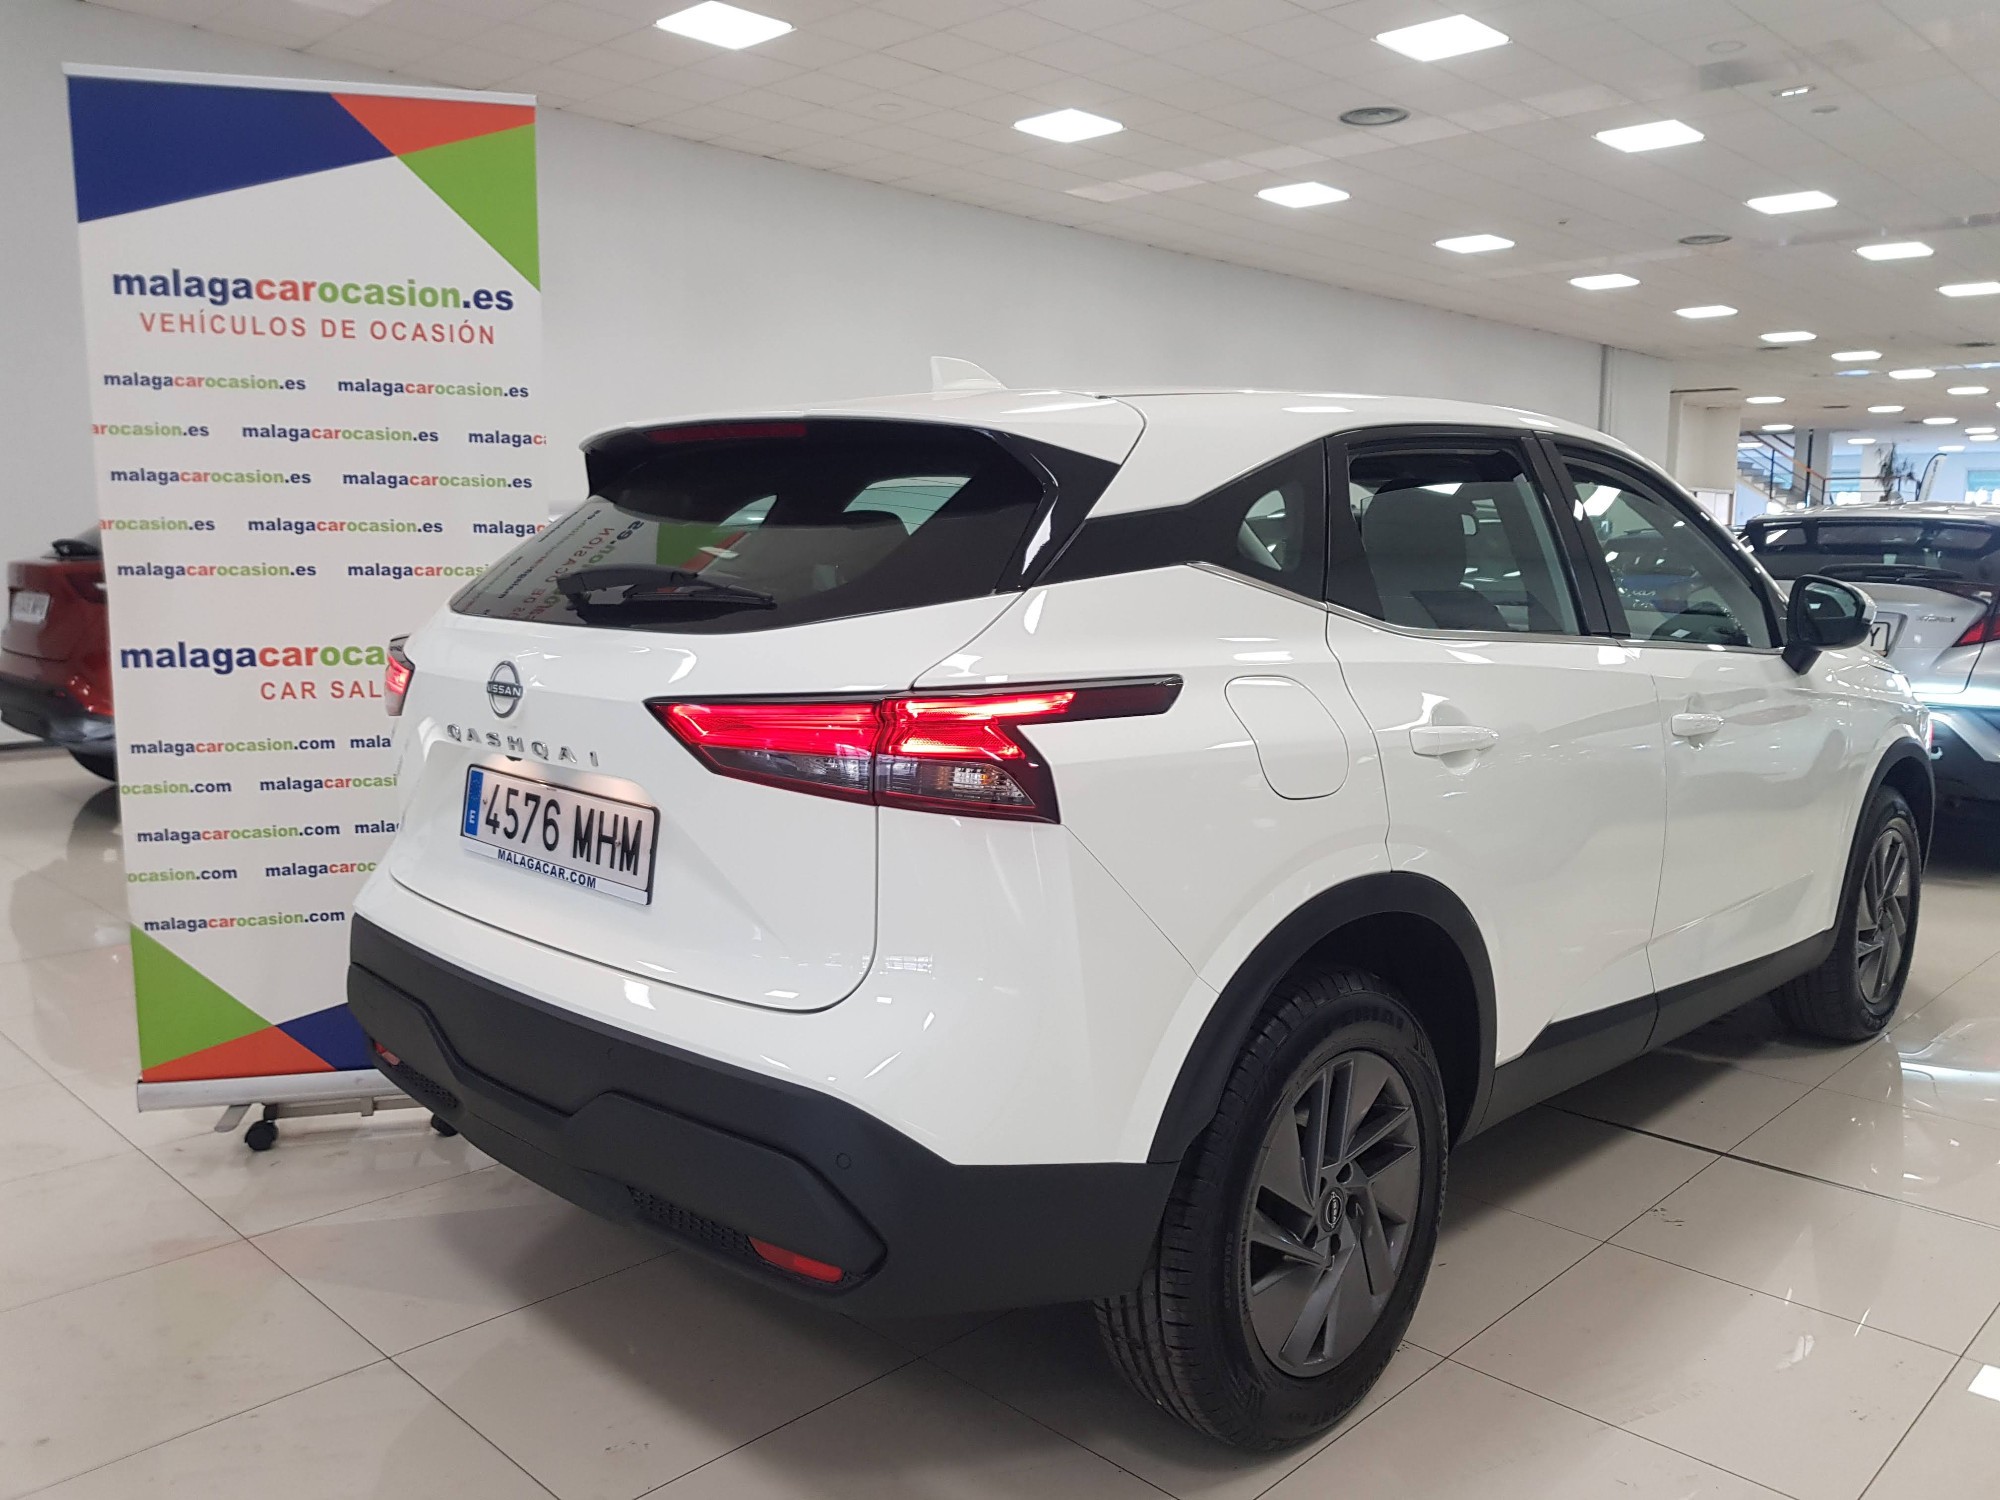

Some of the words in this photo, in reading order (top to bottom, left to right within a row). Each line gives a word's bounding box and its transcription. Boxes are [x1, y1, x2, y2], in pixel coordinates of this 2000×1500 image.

[113, 269, 515, 310] malagacarocasion.es
[140, 309, 305, 337] VEHÍCULOS
[321, 319, 356, 339] DE
[370, 319, 494, 345] OCASIÓN
[104, 371, 307, 391] malagacarocasion.es
[337, 377, 530, 398] malagacarocasion.es
[242, 423, 439, 443] malagacarocasion.es
[110, 467, 311, 486] malagacarocasion.es
[342, 470, 533, 490] malagacarocasion.es
[247, 516, 443, 536] malagacarocasion.es
[473, 520, 546, 538] malagac
[116, 561, 317, 580] malagacarocasion.es
[120, 641, 385, 676] malagacaroca
[260, 681, 317, 701] CAR
[330, 680, 382, 698] SAL
[130, 737, 336, 757] malagacarocasion.com
[350, 734, 392, 749] mala
[447, 723, 600, 767] QASHQAI
[121, 780, 233, 795] ocasion.com
[259, 773, 398, 793] malagacarocasi
[354, 819, 400, 834] mala
[468, 809, 476, 824] E
[137, 824, 341, 845] malagacarocasion.com
[485, 784, 561, 852] 4576
[572, 805, 642, 876] MHM
[127, 868, 238, 883] ocasion.com
[264, 862, 377, 879] malagacaroc
[497, 849, 597, 889] MALAGACAR.COM
[143, 911, 346, 932] malagacarocasion.com
